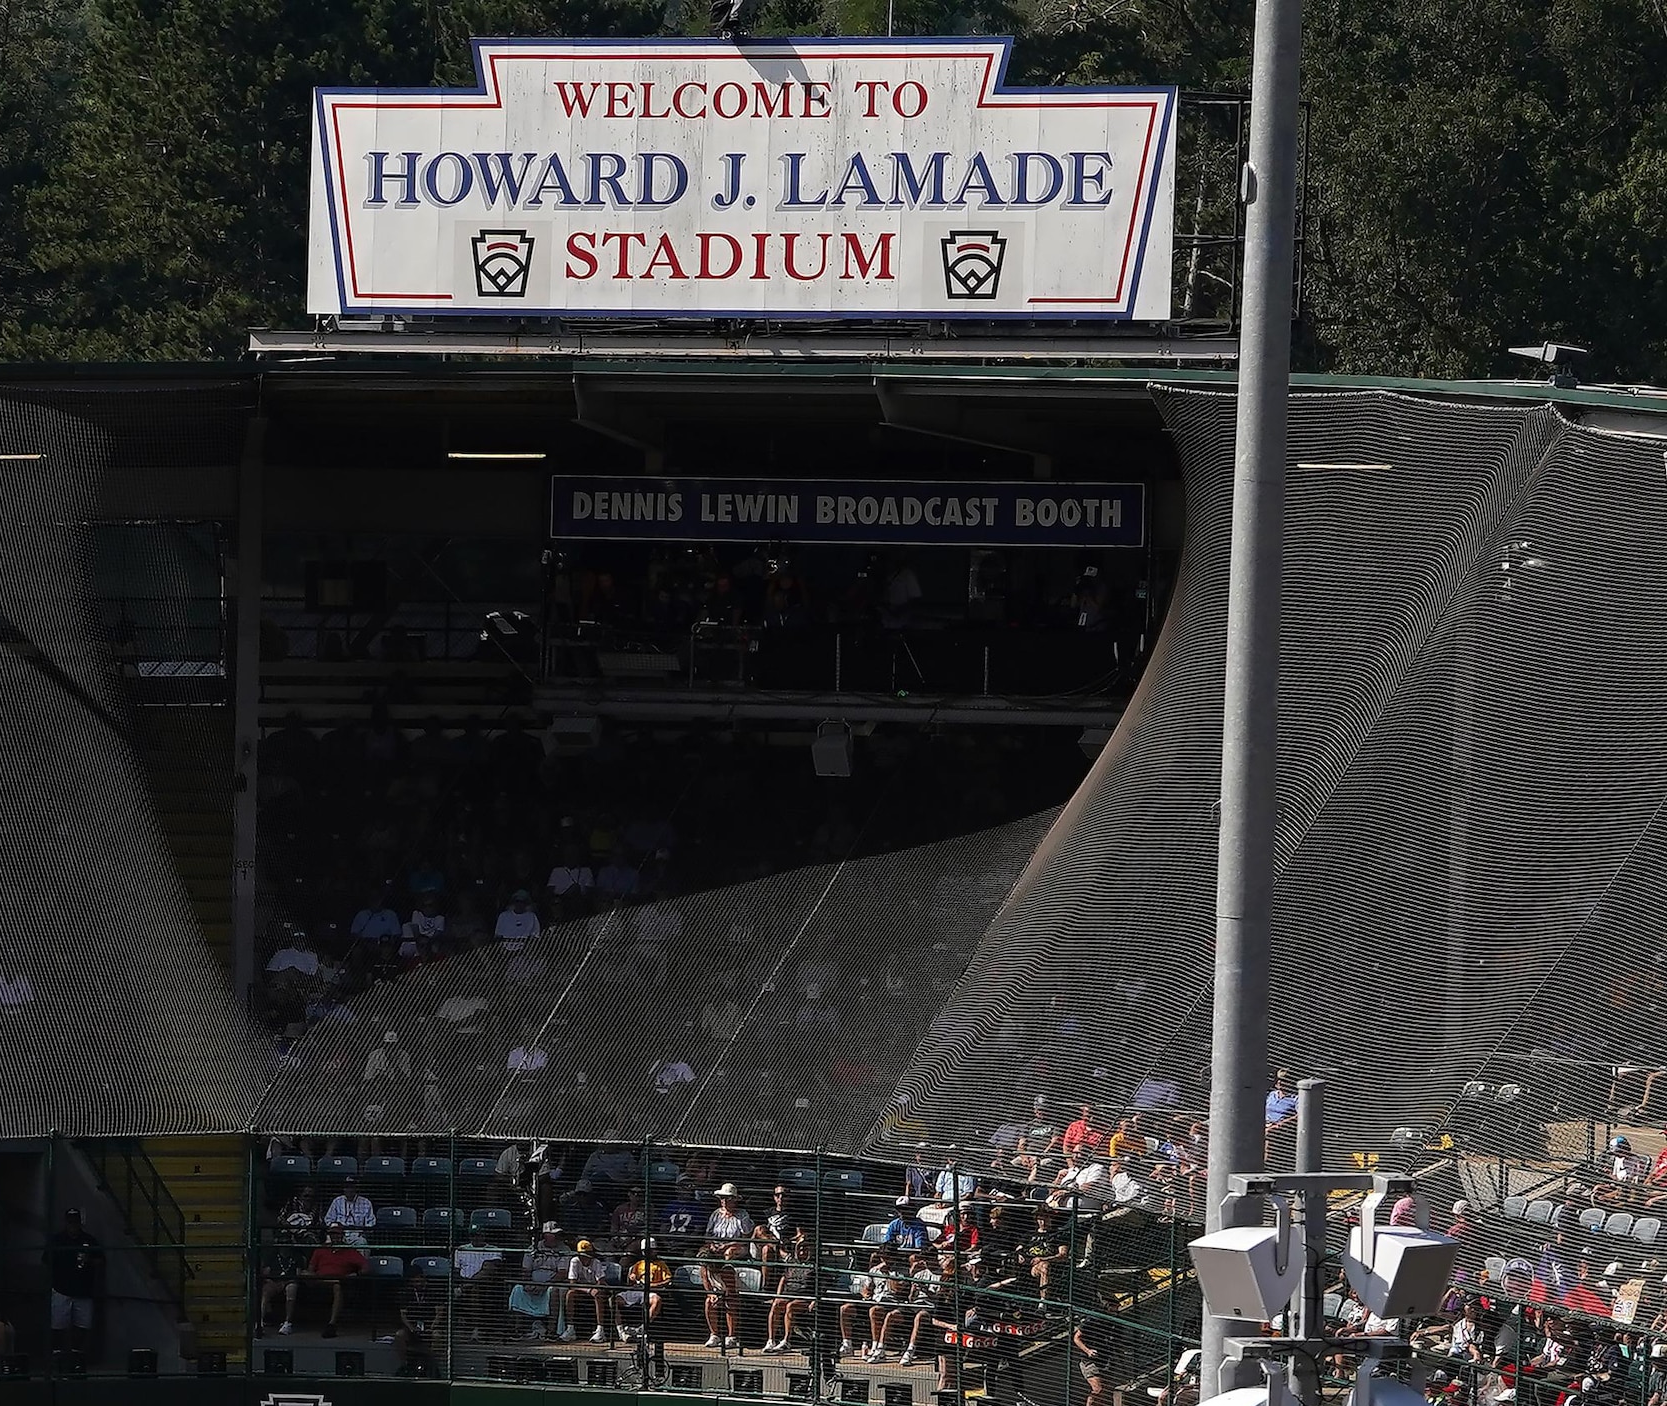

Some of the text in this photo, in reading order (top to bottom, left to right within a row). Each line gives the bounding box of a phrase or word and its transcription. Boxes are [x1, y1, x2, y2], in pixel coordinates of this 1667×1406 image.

[554, 80, 929, 119] WELCOME TO
[363, 151, 1114, 210] HOWARD J. LAMADE
[565, 231, 897, 281] STADIUM
[573, 492, 1123, 529] DENNIS LEWIN BROADCAST BOOTH
